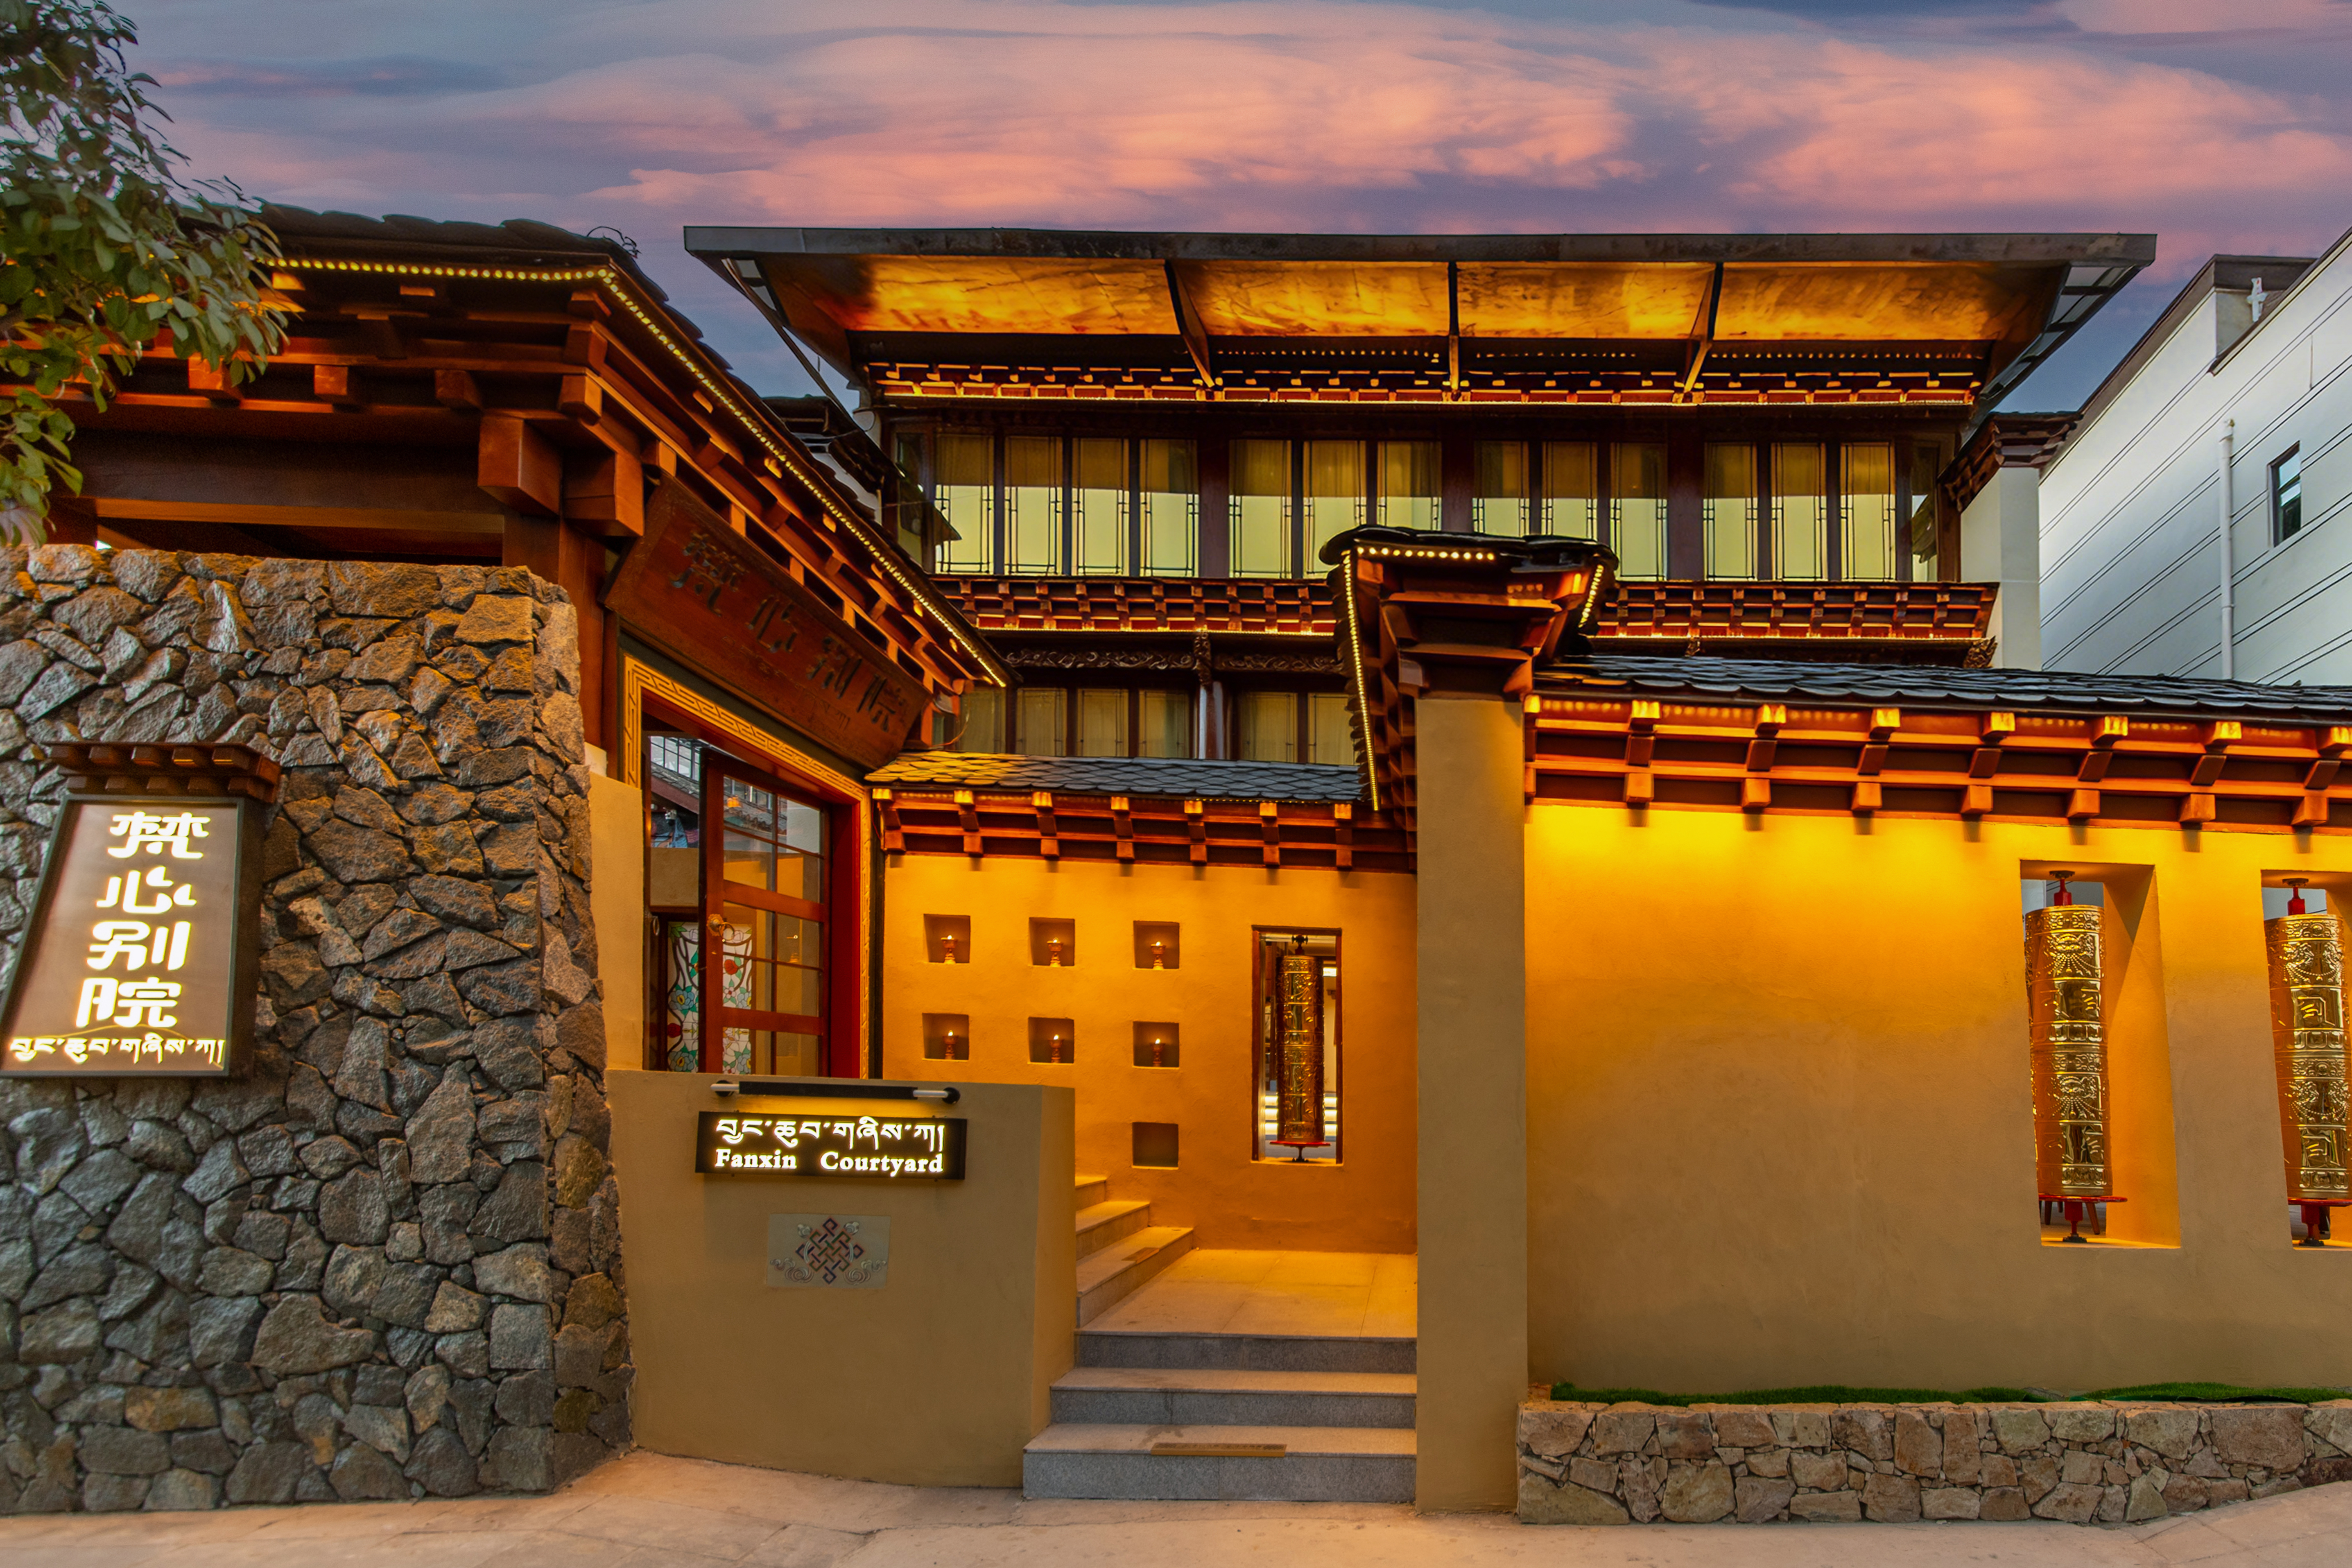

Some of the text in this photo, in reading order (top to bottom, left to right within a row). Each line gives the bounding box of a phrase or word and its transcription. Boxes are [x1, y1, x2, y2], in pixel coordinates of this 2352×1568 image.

[75, 810, 211, 1027] 梵心别院
[715, 1149, 943, 1177] Fanxin Courtyard
